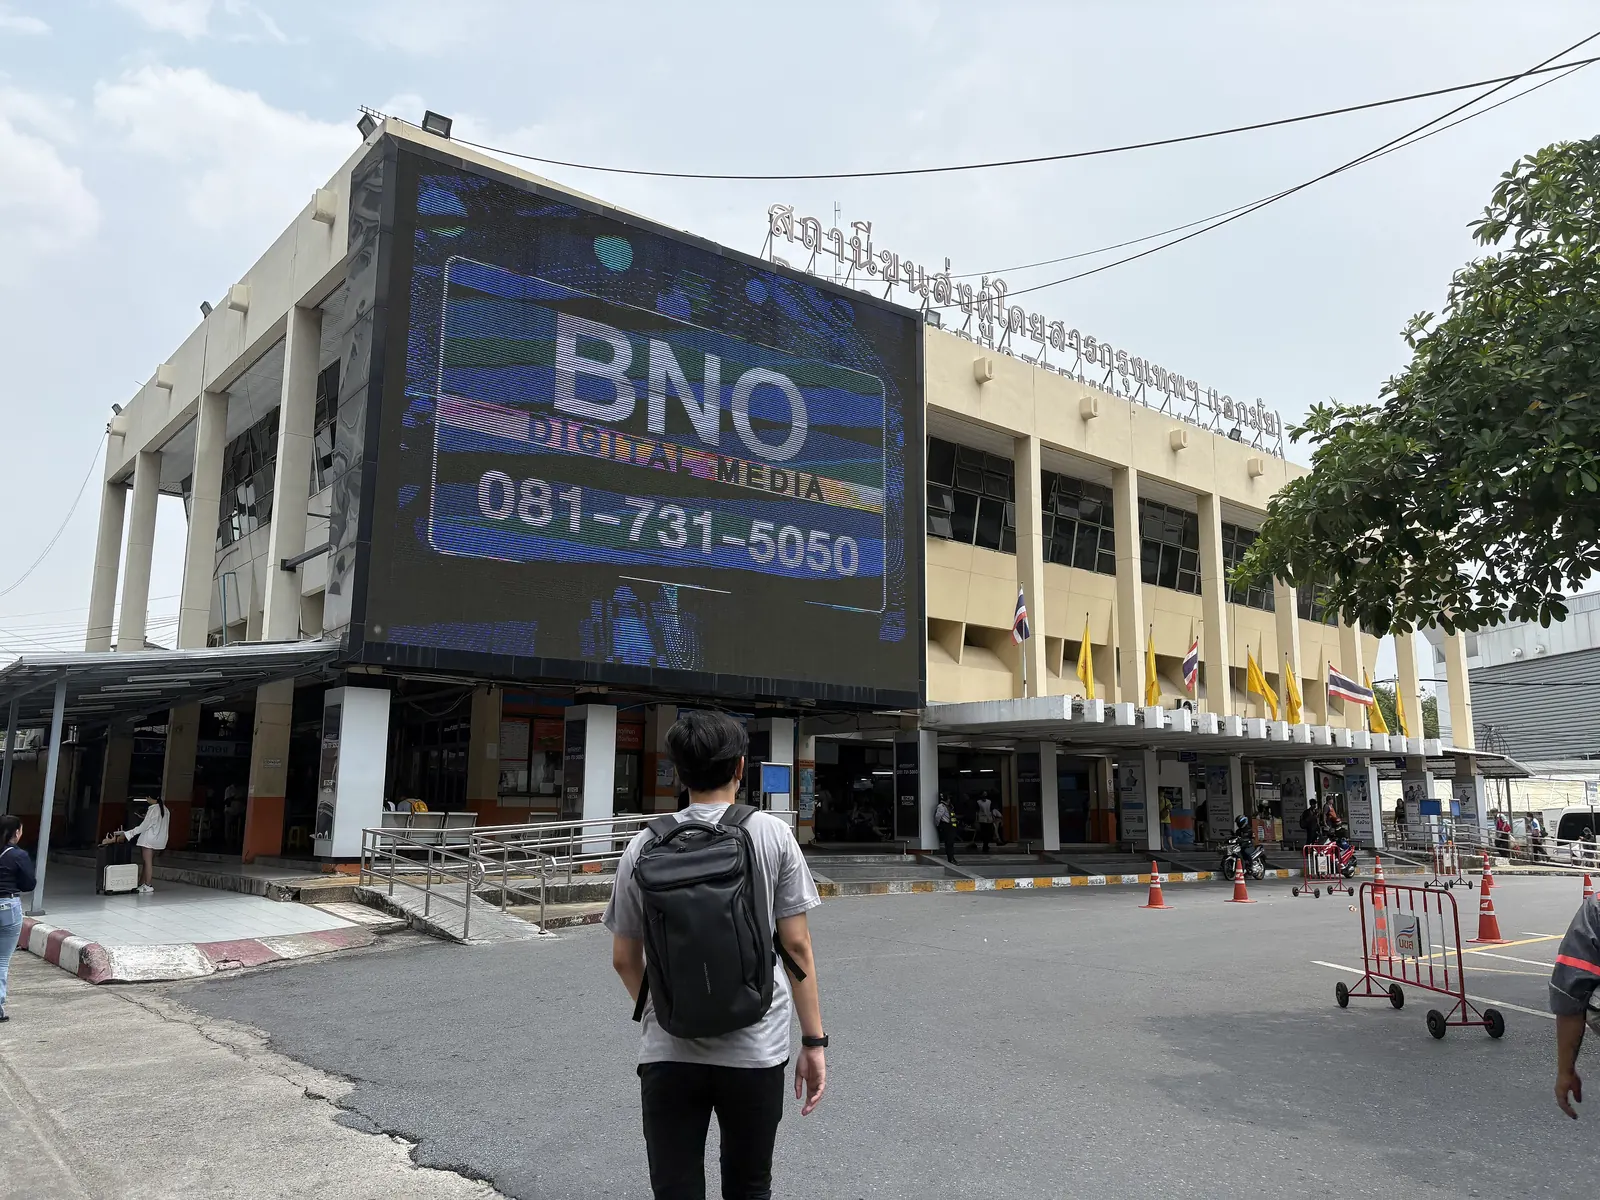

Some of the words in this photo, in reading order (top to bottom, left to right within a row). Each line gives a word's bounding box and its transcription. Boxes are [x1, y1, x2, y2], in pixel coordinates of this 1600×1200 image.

[553, 311, 808, 461] BNO
[528, 412, 692, 474] DIGITAL
[716, 454, 825, 501] MEDIA
[478, 470, 860, 577] 081-731-5050
